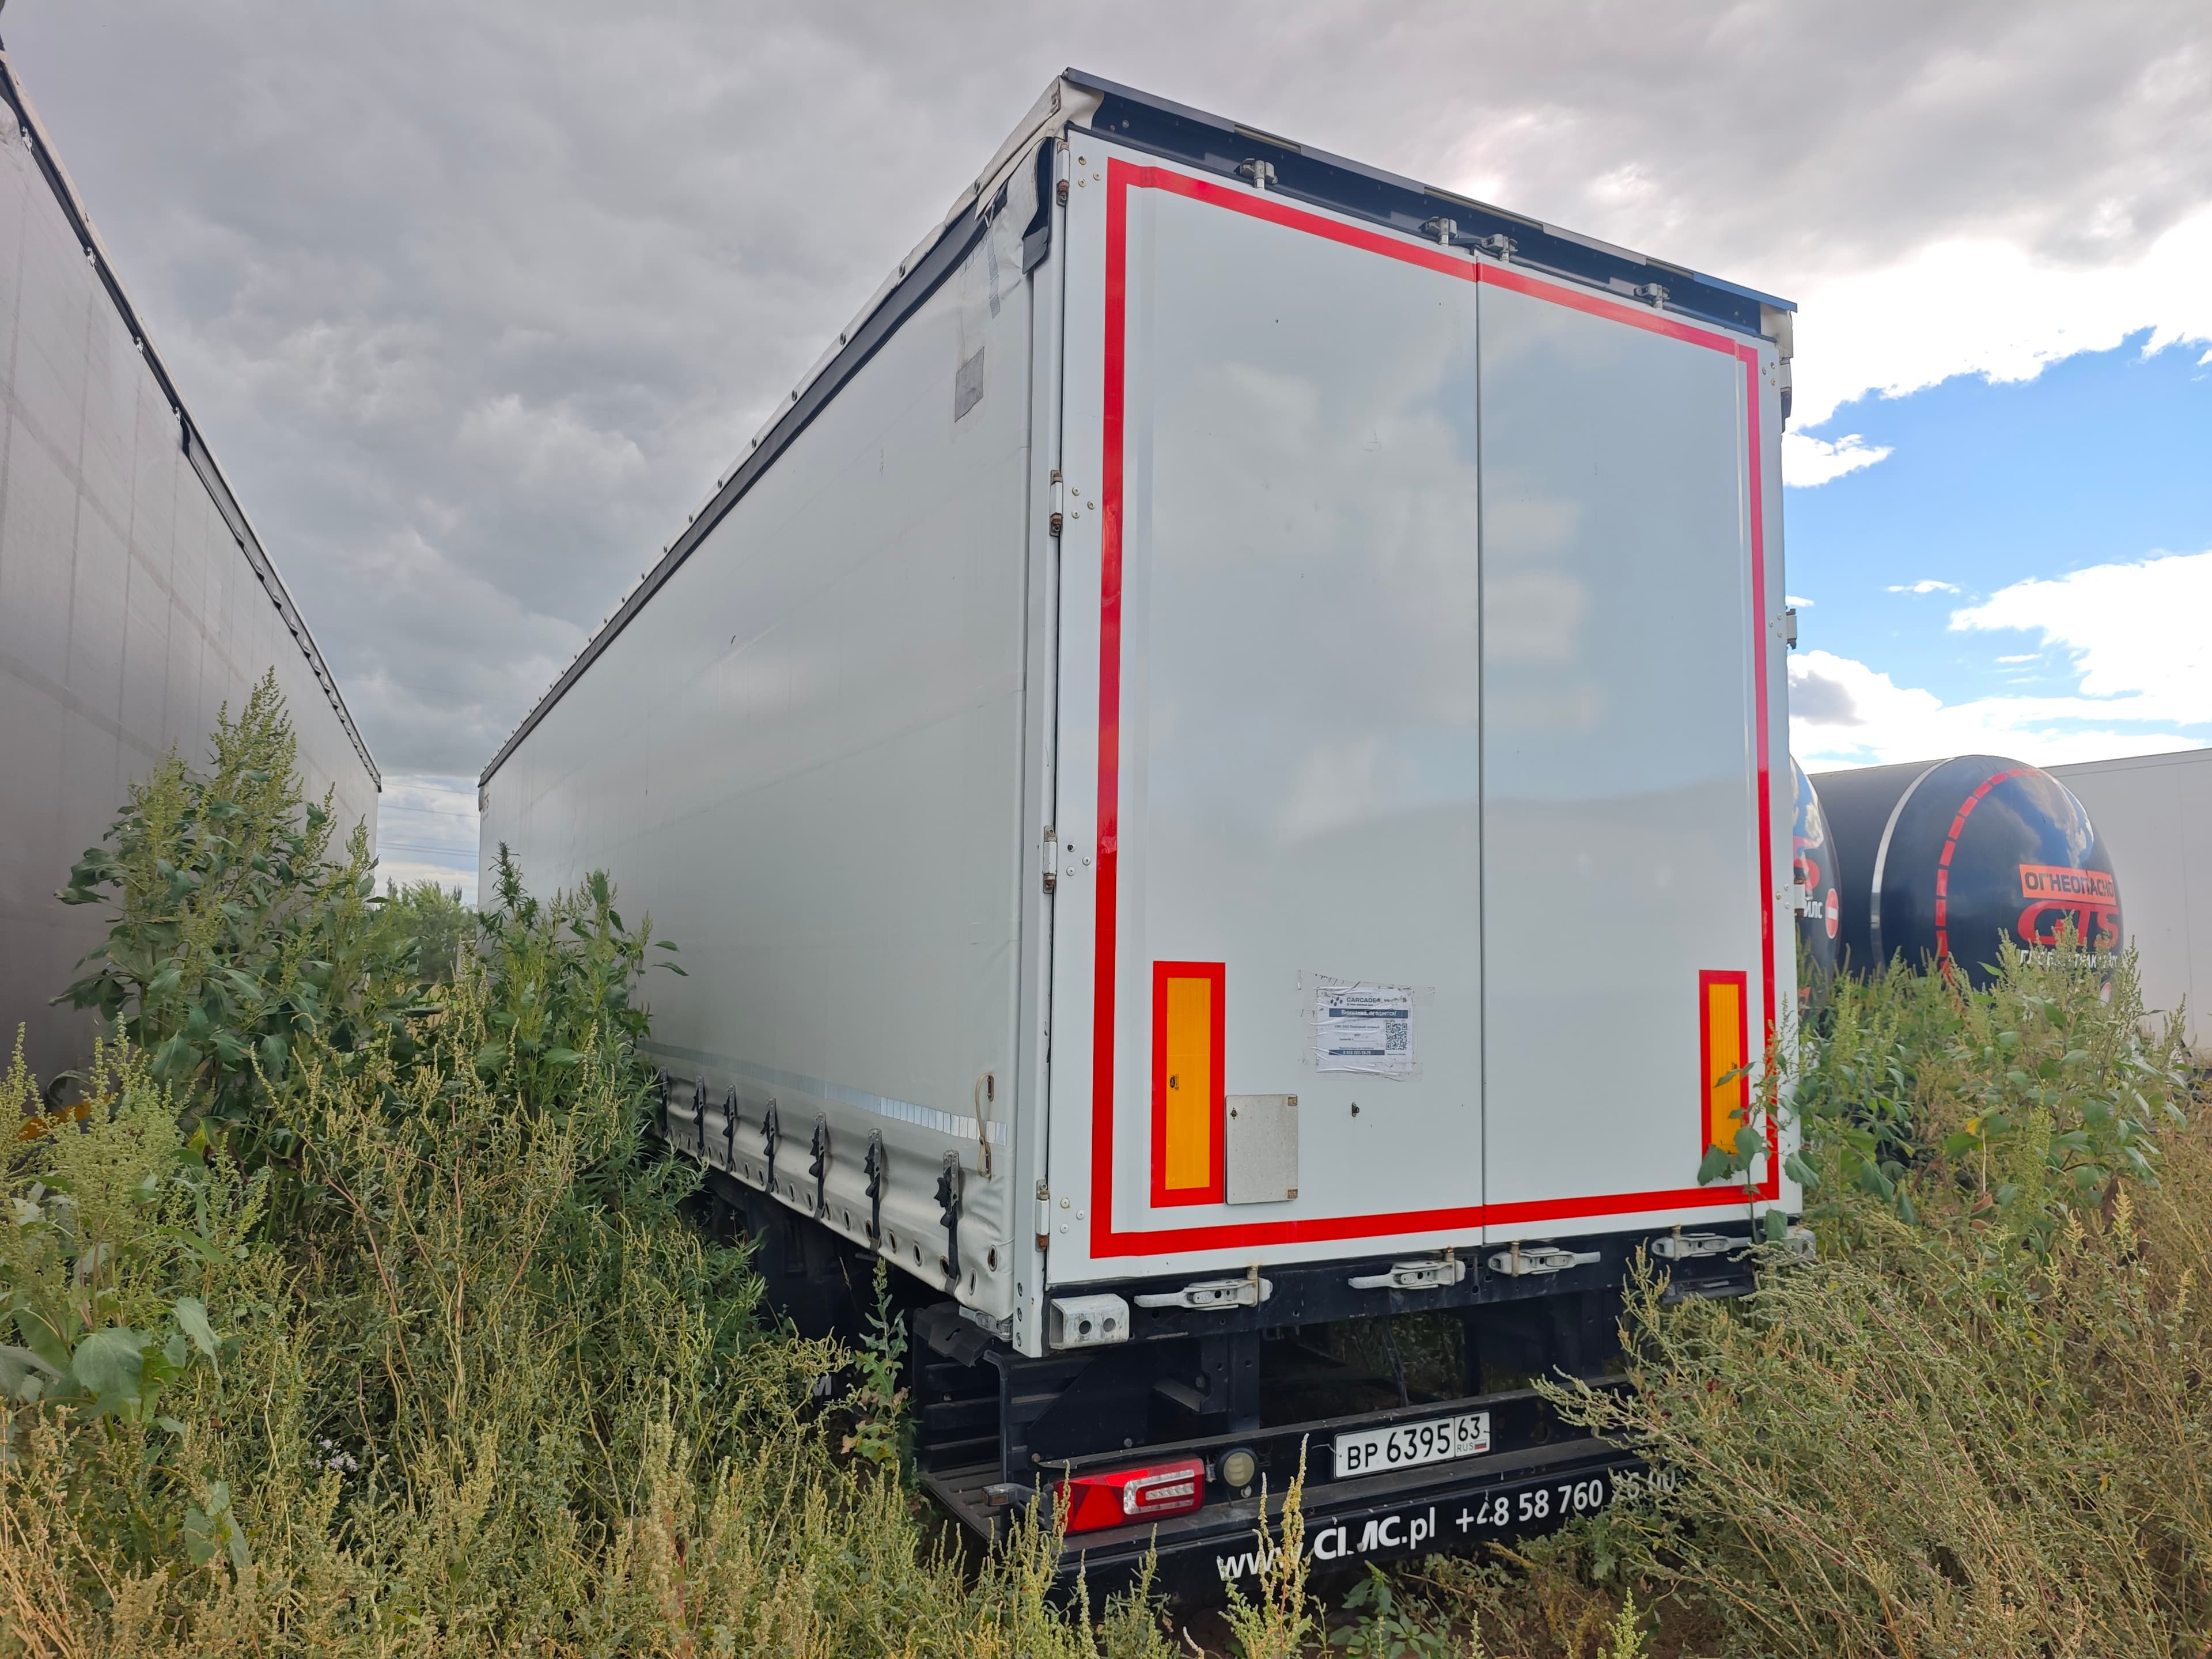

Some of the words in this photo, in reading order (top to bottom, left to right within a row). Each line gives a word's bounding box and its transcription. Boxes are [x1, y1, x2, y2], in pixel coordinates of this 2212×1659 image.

[2024, 872, 2115, 898] ОГНЕОПАСНО
[2018, 900, 2119, 949] GTS
[1387, 1422, 1450, 1463] 6395
[1457, 1416, 1480, 1442] 63
[1456, 1442, 1474, 1453] RUS
[1518, 1489, 1550, 1522] 58
[1558, 1479, 1603, 1514] 760
